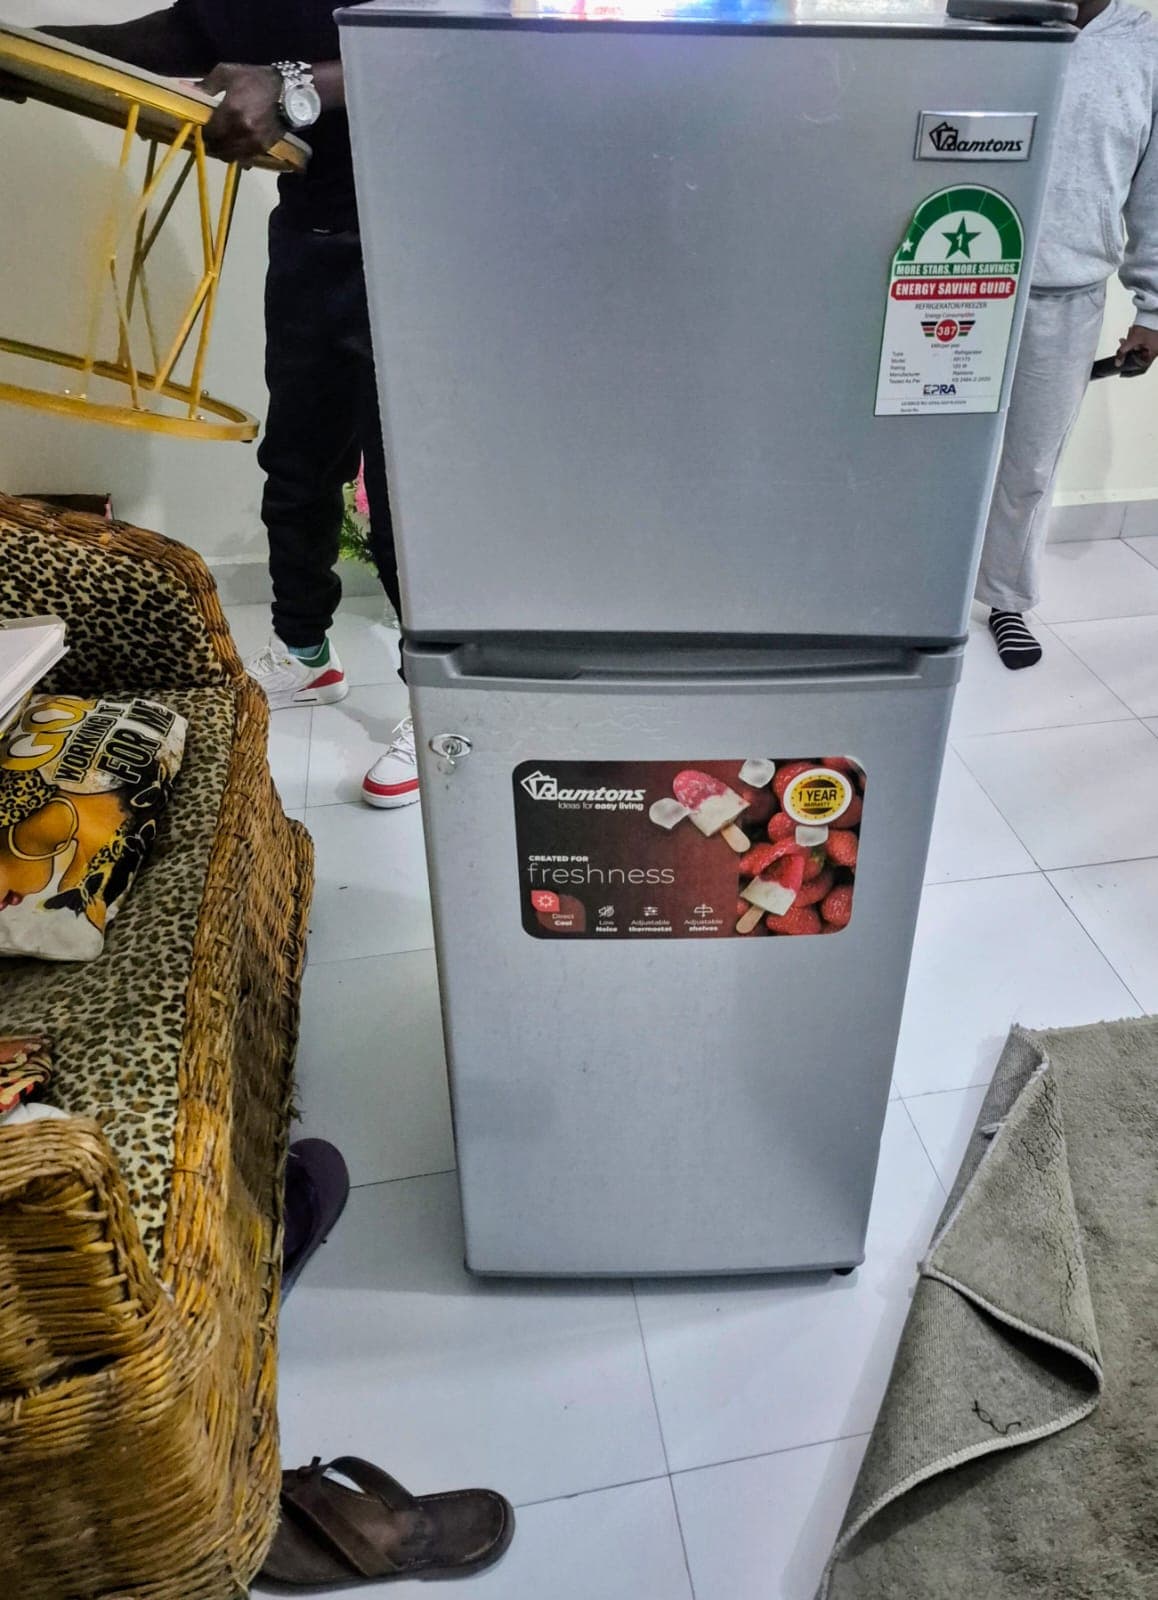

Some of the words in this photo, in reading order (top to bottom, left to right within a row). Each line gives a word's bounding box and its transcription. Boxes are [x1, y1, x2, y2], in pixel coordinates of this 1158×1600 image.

[937, 131, 1024, 152] Ramtons
[956, 233, 963, 249] 1
[896, 265, 921, 275] MORE
[952, 263, 977, 274] MORE
[978, 262, 1015, 274] SAVINGS
[896, 282, 937, 296] ENERGY
[938, 282, 977, 295] SAVING
[979, 281, 1012, 294] GUIDE
[937, 326, 957, 336] 387
[923, 384, 957, 396] EPRA
[52, 716, 117, 784] WORKING
[95, 729, 161, 784] FOR
[534, 779, 646, 801] Ramtons
[798, 790, 803, 802] 1
[806, 789, 837, 802] YEAR
[594, 803, 617, 811] easy
[618, 802, 644, 811] living
[527, 863, 675, 884] freshness
